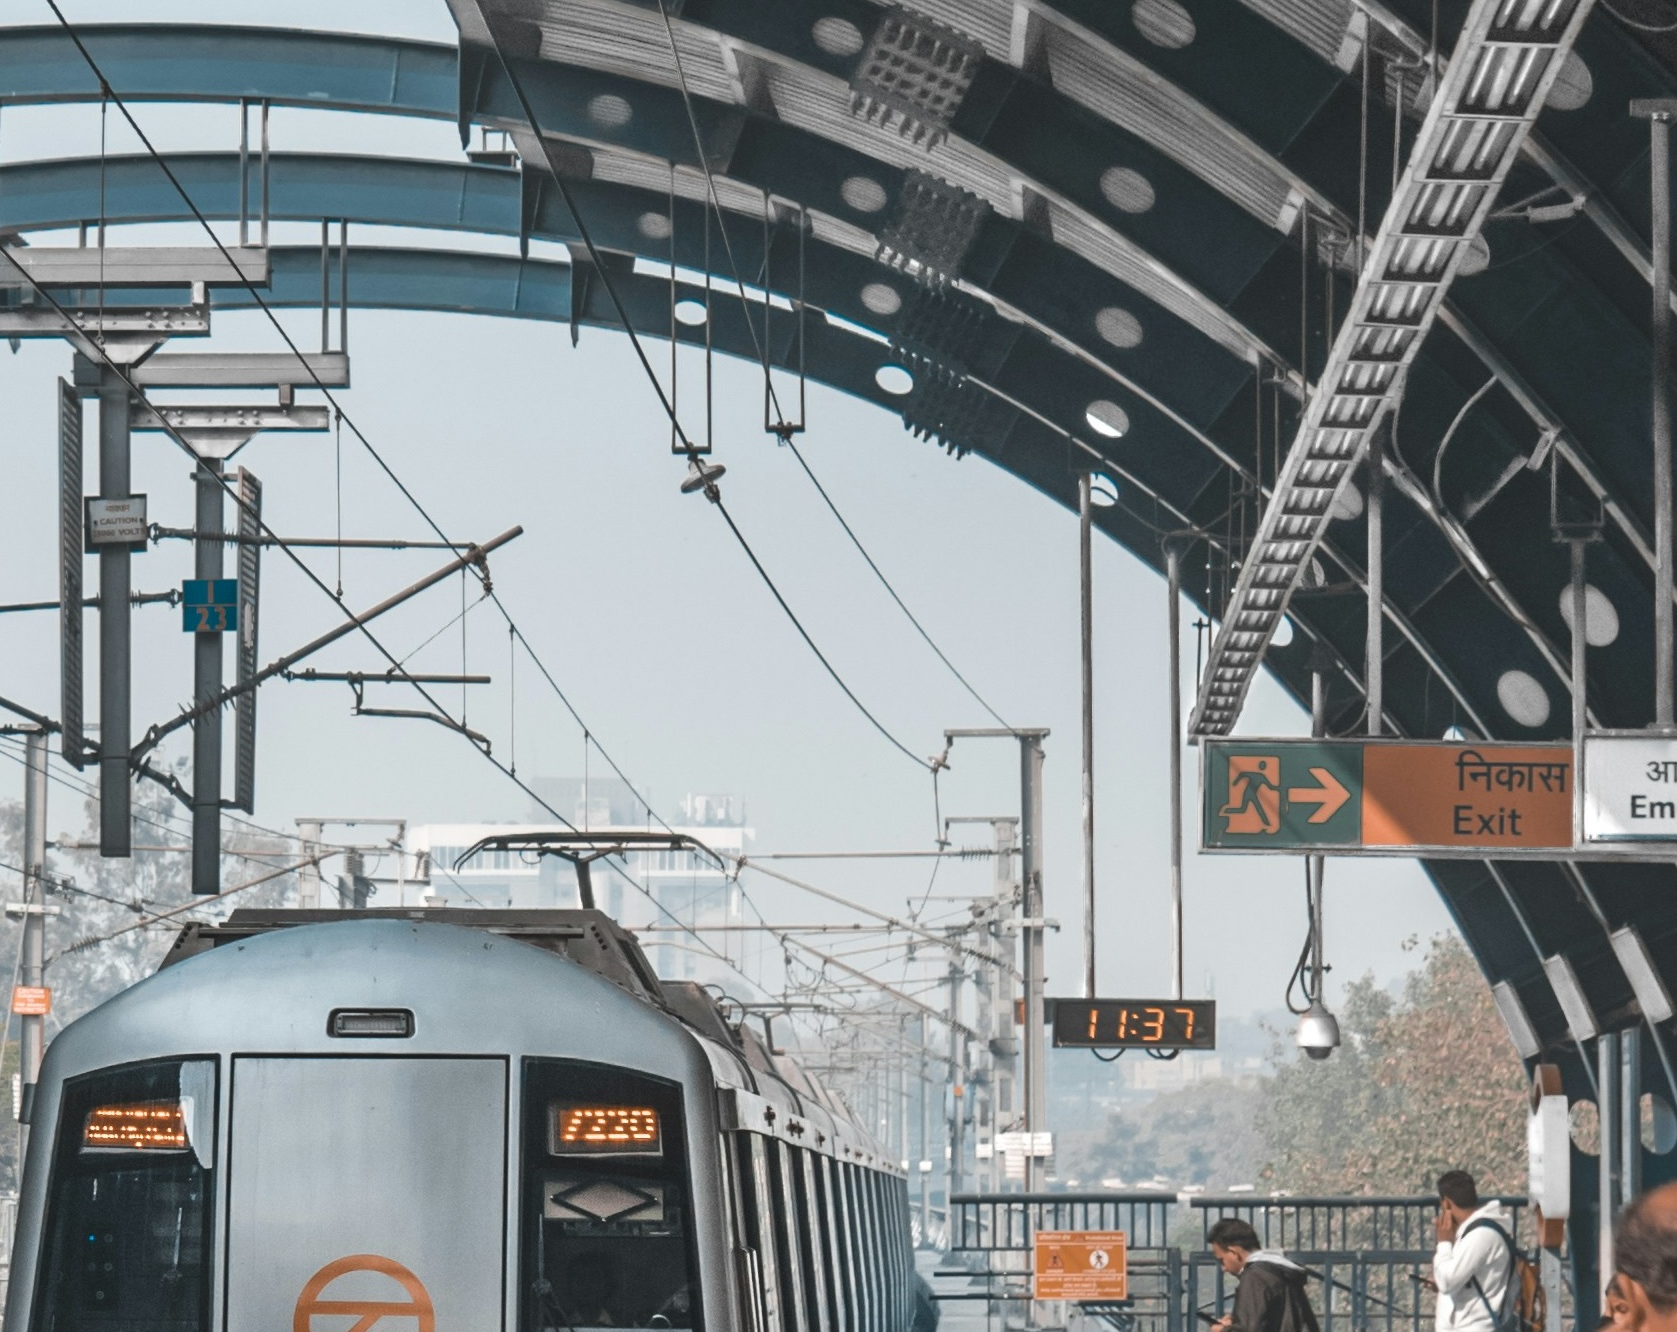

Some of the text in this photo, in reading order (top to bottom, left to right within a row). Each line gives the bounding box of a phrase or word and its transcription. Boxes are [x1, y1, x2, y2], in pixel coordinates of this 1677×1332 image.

[99, 517, 139, 526] CAUTION
[196, 606, 227, 632] 23
[1454, 750, 1570, 793] निकास
[1453, 805, 1522, 836] Exit
[1087, 1007, 1195, 1041] 11:37
